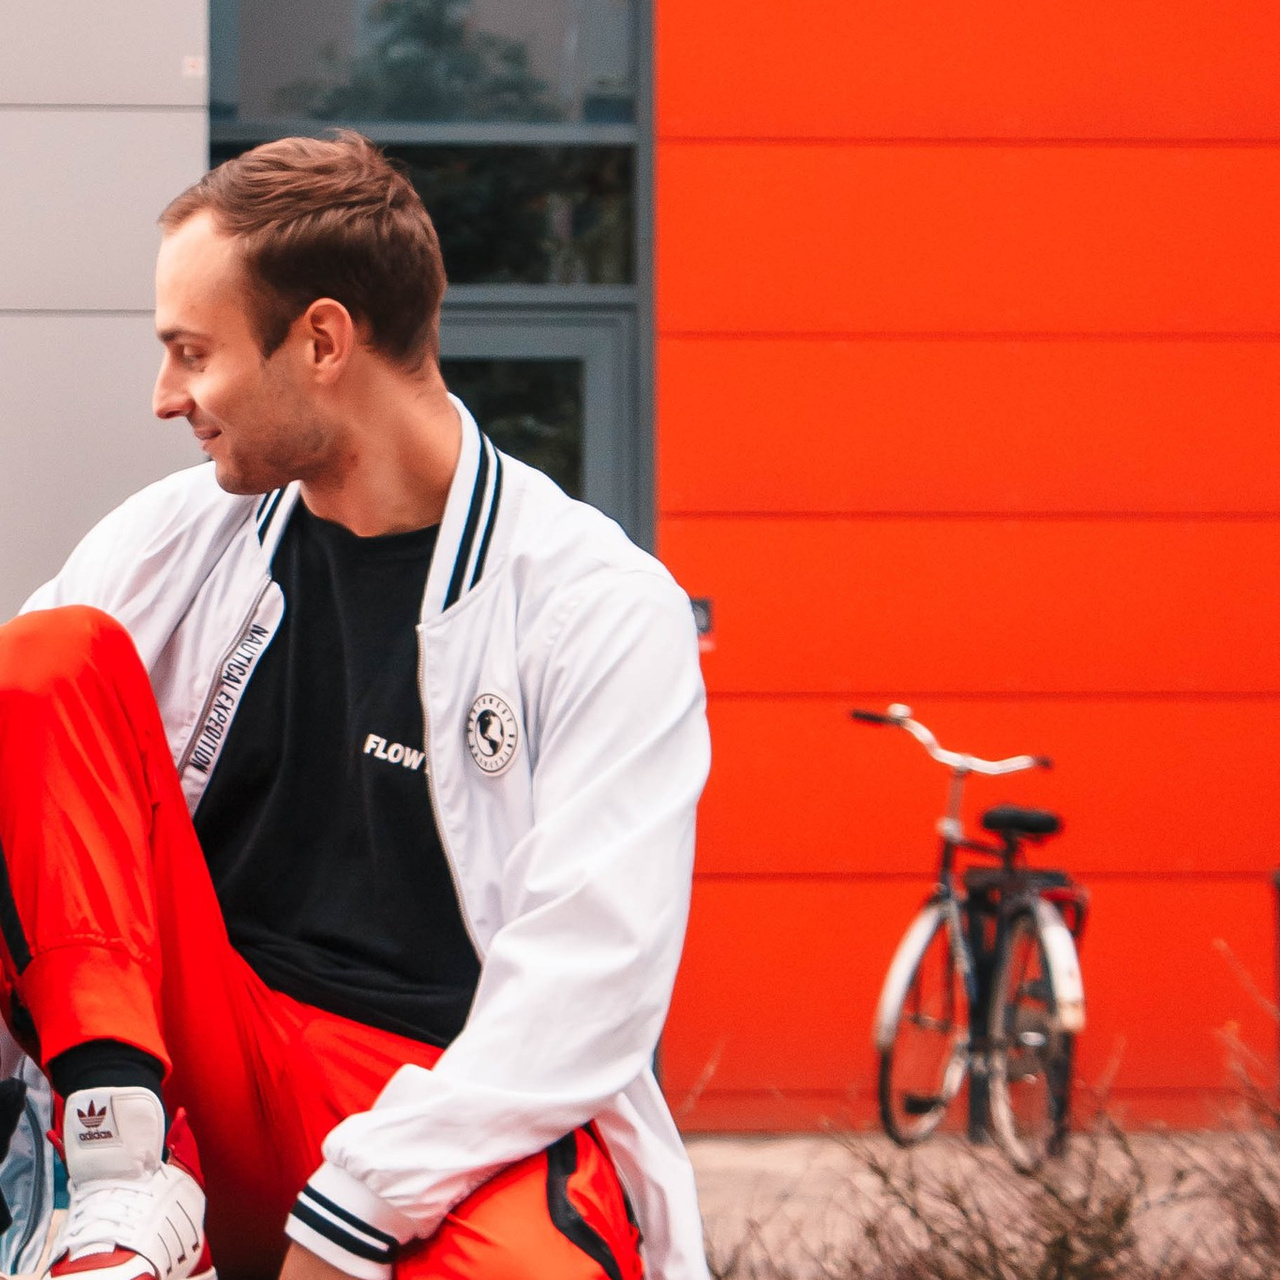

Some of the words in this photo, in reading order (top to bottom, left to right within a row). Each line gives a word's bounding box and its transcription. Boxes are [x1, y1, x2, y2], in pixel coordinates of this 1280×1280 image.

[220, 623, 269, 691] NAUTICAL
[190, 691, 235, 775] EXPEDITION
[363, 733, 426, 770] FLOW
[79, 1129, 113, 1141] adidas
